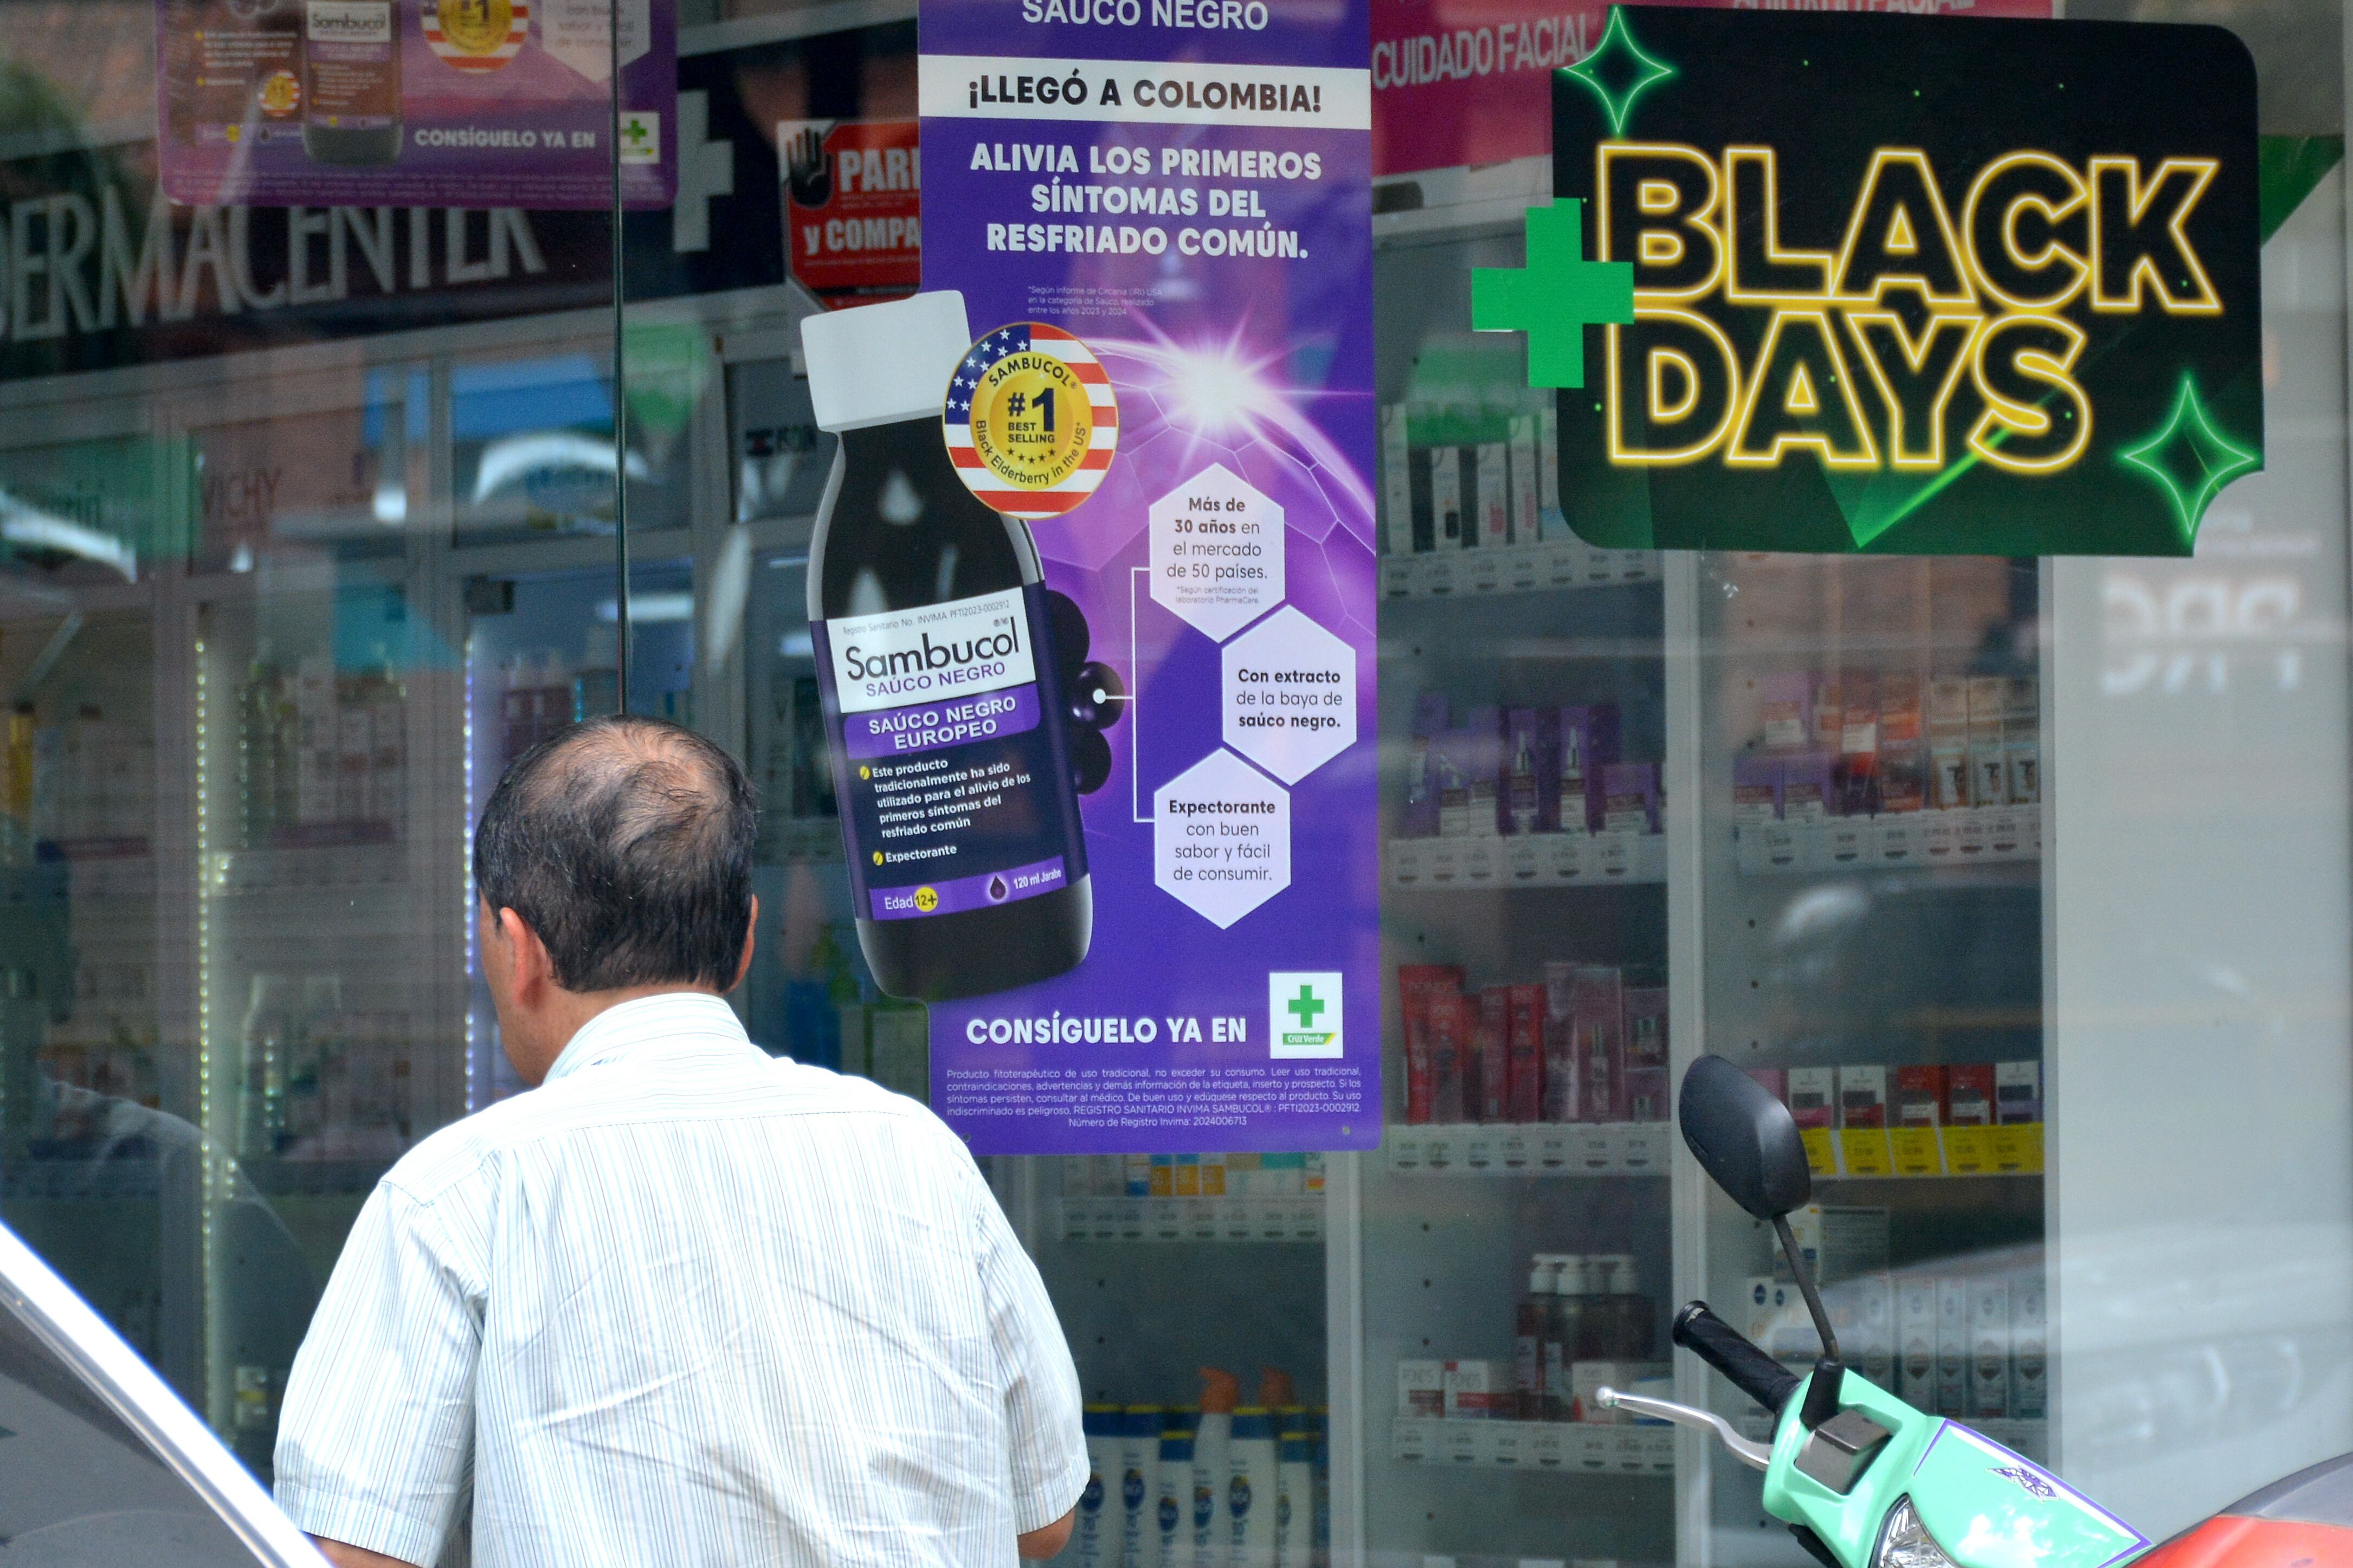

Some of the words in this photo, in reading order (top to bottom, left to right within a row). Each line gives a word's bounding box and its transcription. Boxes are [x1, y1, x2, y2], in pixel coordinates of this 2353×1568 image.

[1152, 0, 1268, 30] NEGRO
[1372, 29, 1494, 89] CUIDADO
[1498, 14, 1592, 73] FACIAL
[970, 69, 1087, 108] ¡LLEGÓ
[1100, 79, 1122, 106] A
[1134, 79, 1320, 113] COLOMBIA!
[543, 132, 565, 147] YA
[572, 132, 595, 148] EN
[971, 143, 1079, 173] ALIVIA
[1090, 146, 1151, 176] LOS
[1162, 149, 1321, 179] PRIMEROS
[1031, 177, 1198, 216] SÍNTOMAS
[1210, 189, 1266, 217] DEL
[1596, 142, 2223, 314] BLACK
[988, 224, 1168, 255] RESFRIADO
[1179, 223, 1308, 259] COMÚN.
[1608, 306, 2092, 475] DAYS
[1008, 388, 1055, 432] #1
[1008, 423, 1036, 431] BEST
[1008, 434, 1055, 443] SELLING
[976, 420, 993, 456] Black
[991, 455, 1049, 485] Elderberry
[1052, 466, 1064, 480] in
[1062, 450, 1079, 468] the
[1189, 496, 1220, 512] Más
[1226, 499, 1245, 511] de
[1175, 520, 1192, 533] 30
[1198, 519, 1236, 534] años
[1241, 523, 1260, 534] en
[1174, 542, 1186, 555] el
[1192, 543, 1261, 556] mercado
[1167, 564, 1186, 578] de
[1192, 565, 1209, 578] 50
[1216, 564, 1267, 582] países.
[869, 620, 899, 633] Sanitario
[901, 617, 916, 628] No.
[918, 612, 947, 625] INVIMA
[846, 616, 1020, 681] Sambucol
[866, 673, 932, 697] SAÚCO
[939, 662, 1005, 687] NEGRO
[1239, 669, 1268, 683] Con
[1275, 670, 1340, 683] extracto
[1237, 691, 1255, 705] de
[1261, 691, 1274, 705] la
[1281, 691, 1318, 709] baya
[1324, 692, 1342, 705] de
[869, 711, 939, 735] SAÚCO
[946, 696, 1016, 722] NEGRO
[1239, 712, 1285, 727] saúco
[1291, 715, 1340, 731] negro.
[895, 719, 997, 750] EUROPEO
[872, 767, 893, 778] Este
[895, 759, 948, 777] producto
[874, 771, 968, 792] tradicionalmente
[970, 767, 985, 778] ha
[988, 762, 1010, 776] sido
[877, 795, 921, 808] utilizado
[925, 791, 950, 804] para
[954, 784, 965, 797] el
[969, 781, 999, 795] alivio
[1002, 777, 1015, 788] de
[1017, 773, 1030, 784] los
[879, 810, 925, 825] primeros
[928, 799, 981, 817] síntomas
[984, 795, 1002, 808] del
[1169, 799, 1275, 817] Expectorante
[881, 823, 927, 838] resfriado
[930, 817, 971, 831] común
[1187, 824, 1214, 836] con
[1221, 822, 1259, 836] buen
[886, 844, 957, 864] Expectorante
[1175, 844, 1219, 857] sabor
[1224, 847, 1232, 861] y
[1238, 844, 1270, 858] fácil
[1174, 866, 1192, 880] de
[1198, 869, 1272, 880] consumir.
[885, 895, 913, 911] Edad
[915, 894, 937, 907] 12+
[1014, 877, 1028, 889] 120
[1029, 873, 1040, 885] ml
[1041, 868, 1061, 883] Jarabe
[966, 1010, 1157, 1044] CONSÍGUELO
[1167, 1018, 1202, 1042] YA
[1212, 1018, 1246, 1042] EN
[947, 1070, 989, 1079] Producto
[994, 1069, 1060, 1080] fitoterapéutico
[947, 1082, 1034, 1092] contraindicaciones,
[1036, 1082, 1092, 1090] advertencias
[1103, 1081, 1132, 1090] demás
[1135, 1081, 1187, 1089] información
[1339, 1080, 1347, 1088] Si
[947, 1095, 988, 1103] síntomas
[1036, 1094, 1076, 1102] consultar
[1080, 1093, 1087, 1102] al
[1143, 1093, 1165, 1101] buen
[1194, 1092, 1236, 1103] edúquese
[1239, 1093, 1277, 1102] respecto
[1279, 1092, 1287, 1100] al
[947, 1107, 1013, 1115] indiscriminado
[1074, 1106, 1121, 1114] REGISTRO
[1124, 1105, 1174, 1113] SANITARIO
[1069, 1118, 1105, 1127] Número
[1107, 1118, 1118, 1126] de
[1121, 1118, 1157, 1127] Registro
[1160, 1118, 1190, 1126] Invima:
